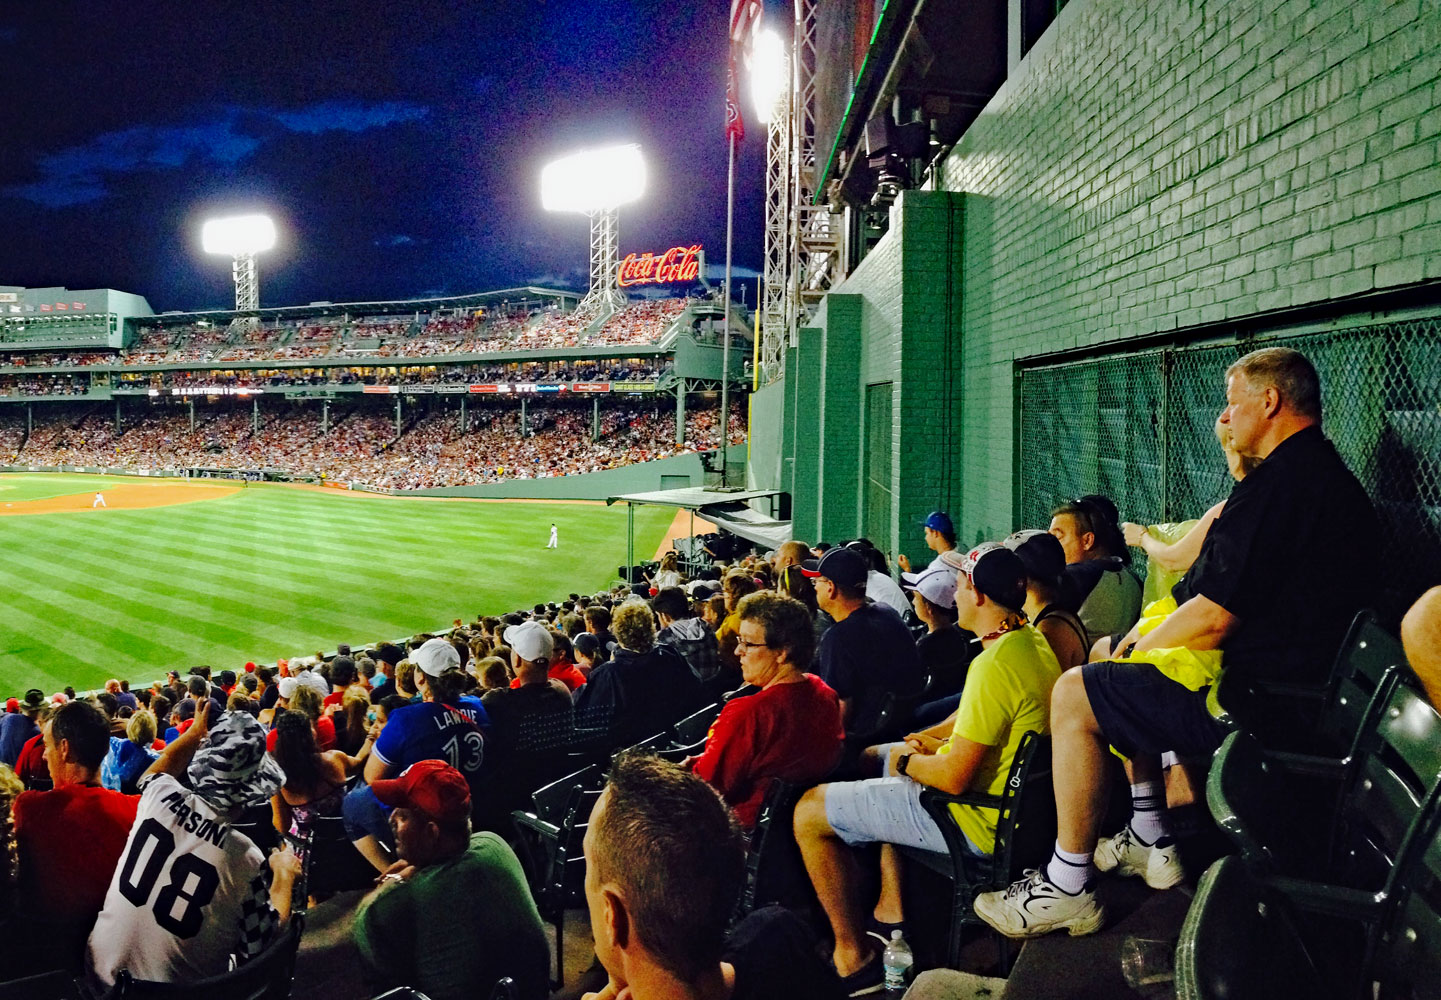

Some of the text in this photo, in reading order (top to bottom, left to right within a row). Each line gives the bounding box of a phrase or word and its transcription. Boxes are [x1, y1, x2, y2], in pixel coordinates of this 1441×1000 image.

[617, 244, 703, 287] Coca-Cola
[441, 731, 484, 772] 13
[160, 791, 227, 849] PERSON
[119, 817, 220, 940] 08
